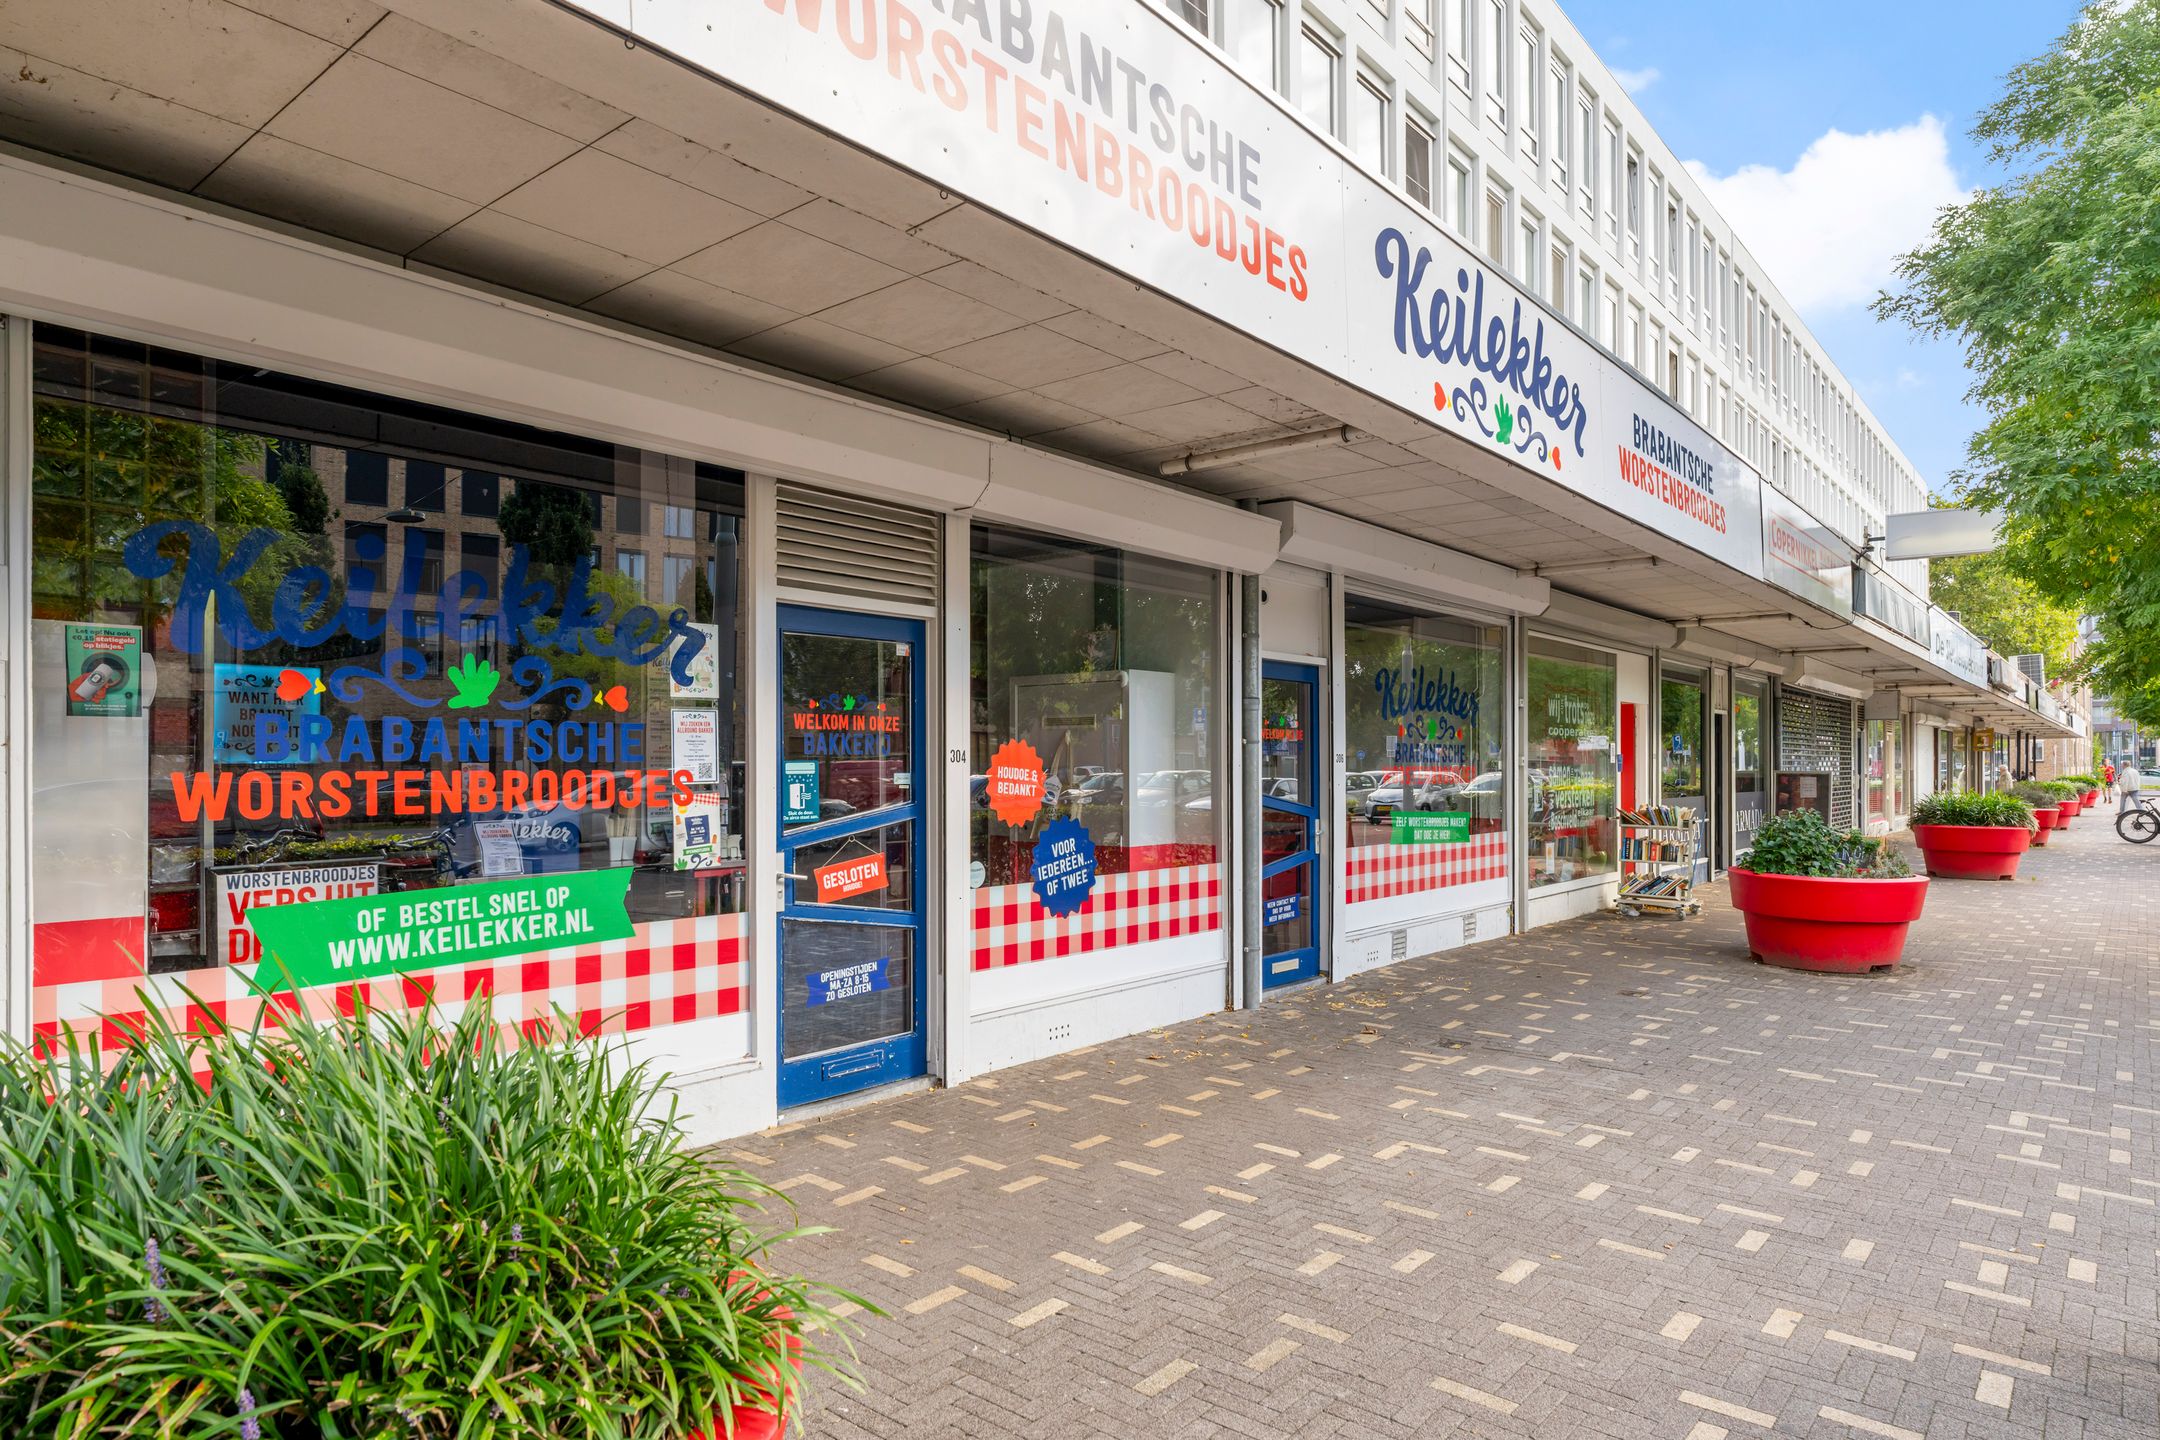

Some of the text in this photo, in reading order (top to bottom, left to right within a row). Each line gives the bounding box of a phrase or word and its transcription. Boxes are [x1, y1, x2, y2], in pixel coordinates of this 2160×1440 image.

[1375, 227, 1588, 458] Keilekker
[1633, 412, 1714, 495] BRABANTSCHE
[1618, 444, 1727, 535] WORSTENBROODJES
[123, 520, 706, 688] Keilekker
[228, 690, 269, 705] WANT
[1375, 665, 1480, 728] Keilekker
[793, 712, 900, 732] WELKOM IN ONZE
[256, 714, 646, 762] BRABANTSCHE
[803, 732, 891, 756] BAKKERIJ
[950, 749, 967, 764] 304
[997, 765, 1039, 783] HOUDOE &
[171, 769, 695, 823] WORSTENBROODJES
[997, 781, 1038, 797] BEDANKT
[1051, 838, 1076, 858] VOOR
[226, 866, 376, 890] WORSTENBROODJES
[823, 861, 880, 890] GESLOTEN
[1046, 868, 1089, 896] OF TWEE
[356, 886, 570, 934] OF BESTEL SNEL OP
[328, 907, 594, 969] WWW.KEILEKKER.NL
[820, 961, 878, 984] OPENINGSTIJDEN
[829, 972, 869, 991] MA-ZA 8-15
[825, 981, 872, 1002] ZO GESLOTEN
